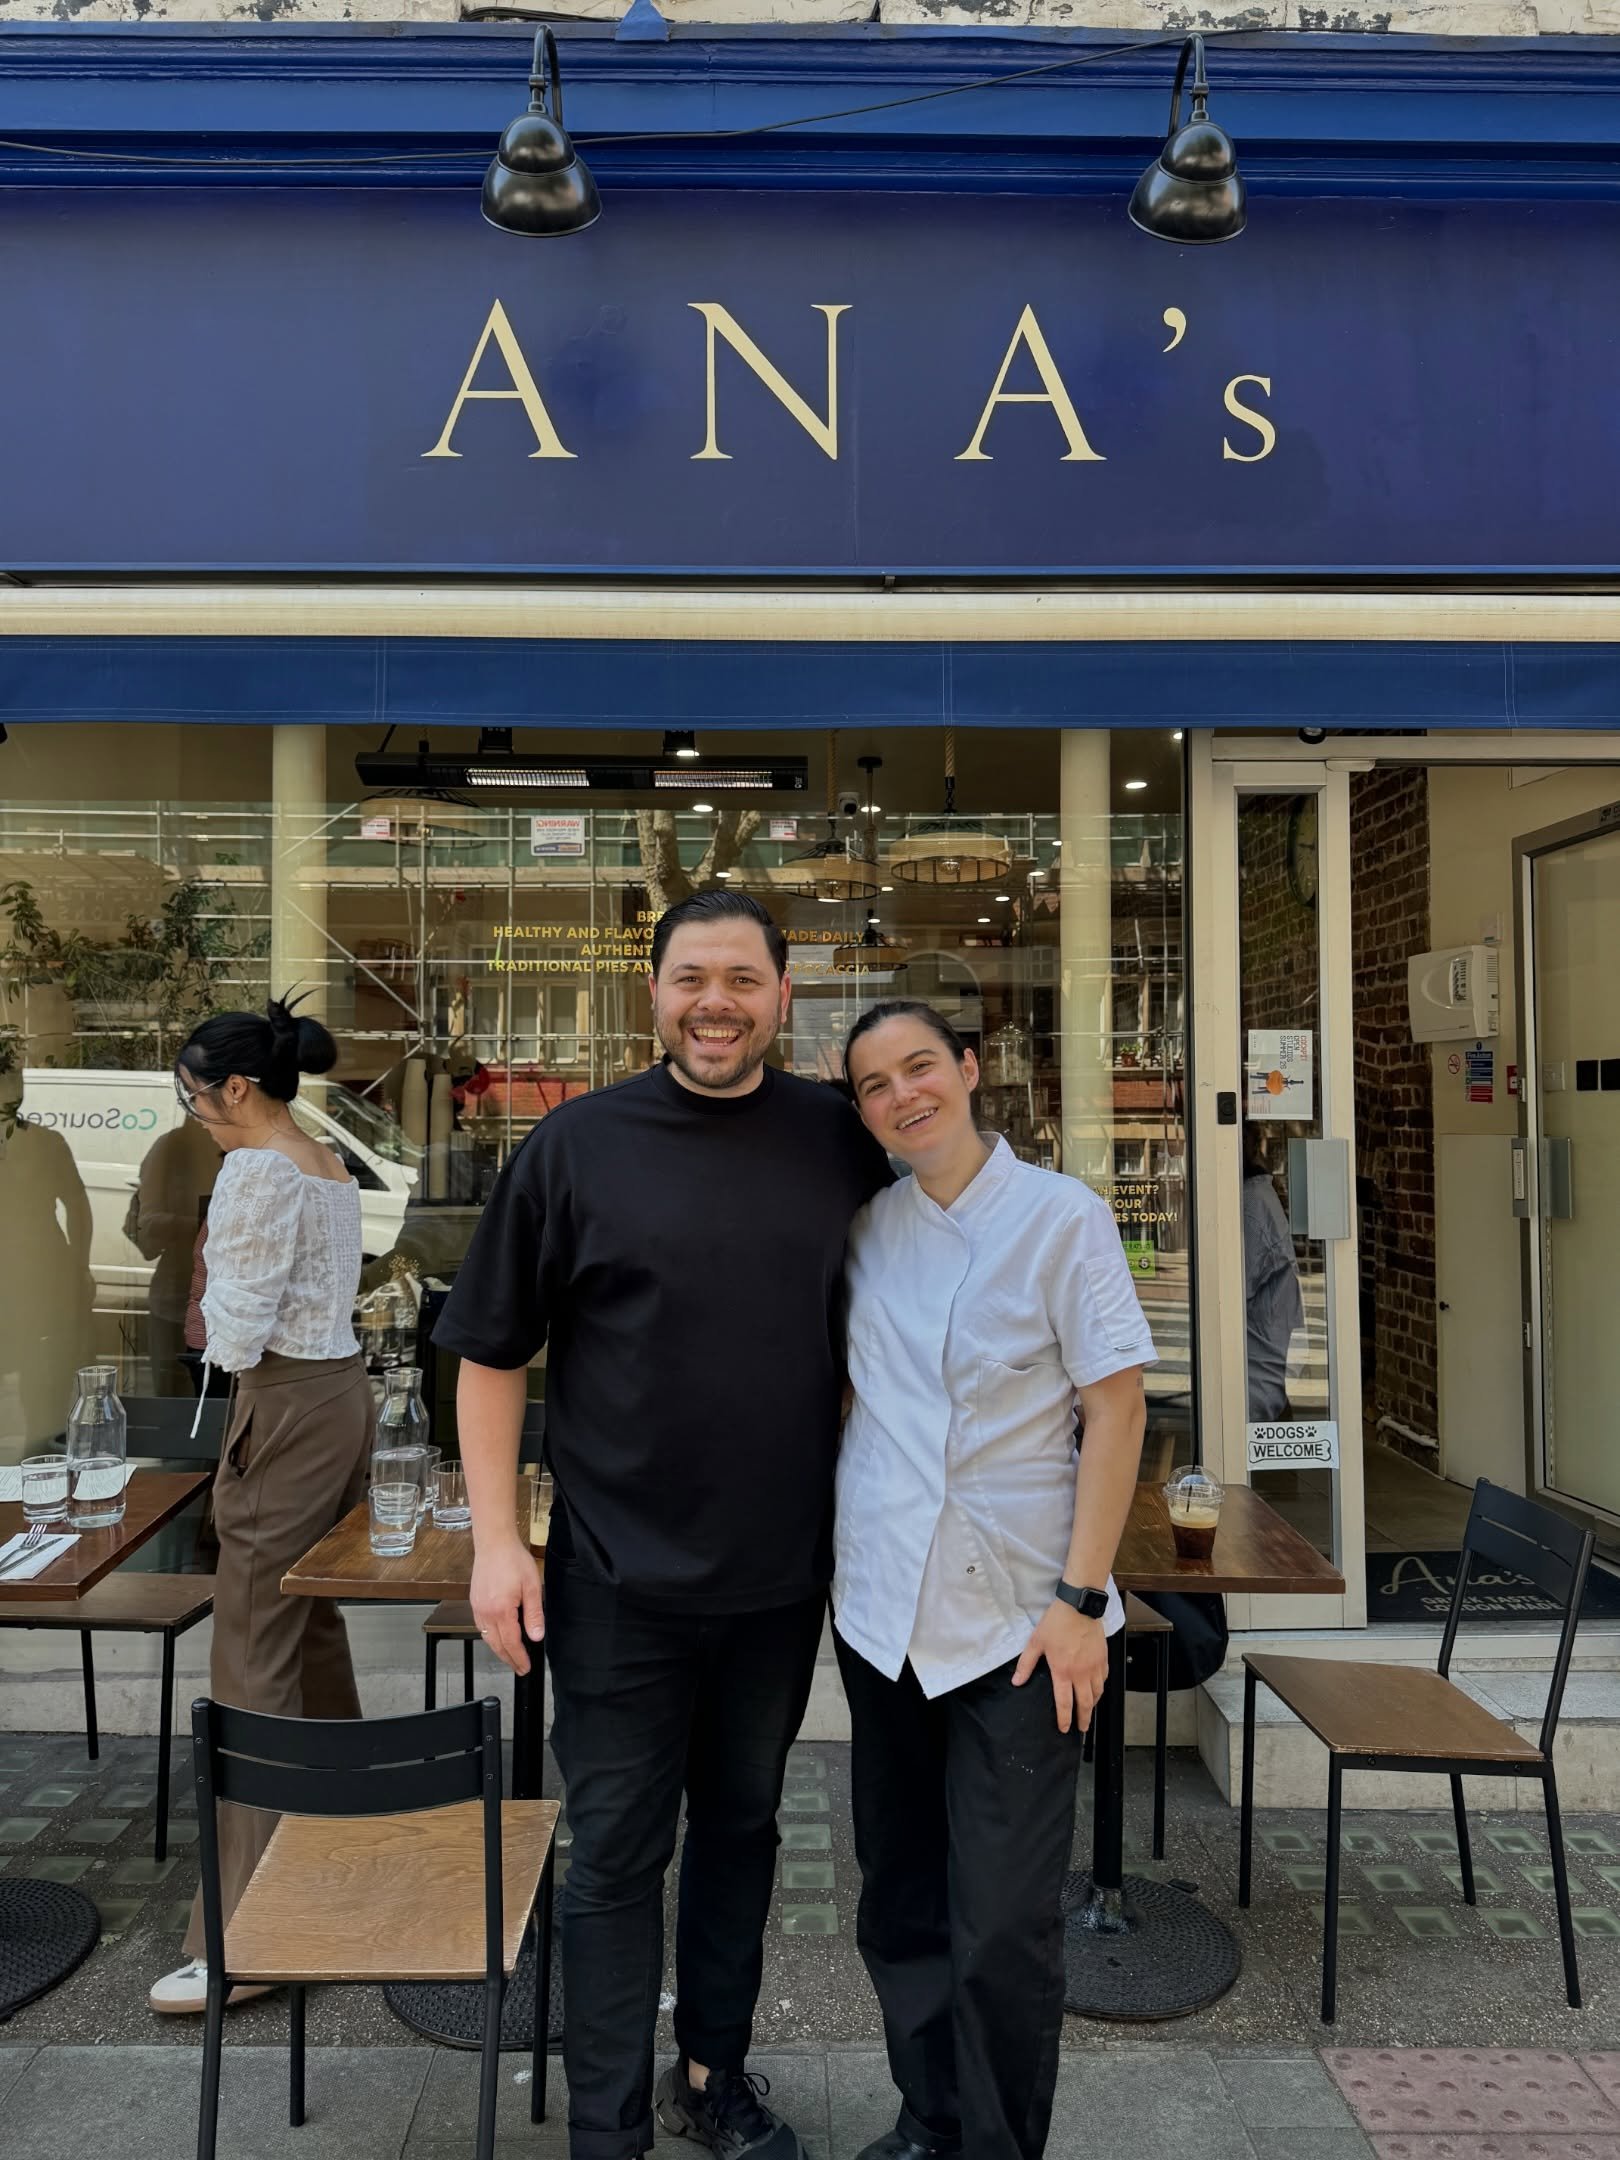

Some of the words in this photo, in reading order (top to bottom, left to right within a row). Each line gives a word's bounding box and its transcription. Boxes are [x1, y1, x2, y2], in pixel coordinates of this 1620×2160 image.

[493, 926, 563, 938] HEALTHY
[566, 927, 600, 939] AND
[822, 930, 865, 943] DAILY
[487, 960, 591, 972] TRADITIONAL
[596, 962, 629, 973] PIES
[1113, 1184, 1159, 1195] EVENT?
[1114, 1198, 1142, 1209] OUR
[1131, 1212, 1178, 1222] TODAY!
[1266, 1426, 1304, 1439] DOGS
[1254, 1444, 1323, 1457] WELCOME
[1424, 1603, 1507, 1612] LODON
[1506, 1602, 1567, 1611] MADE
